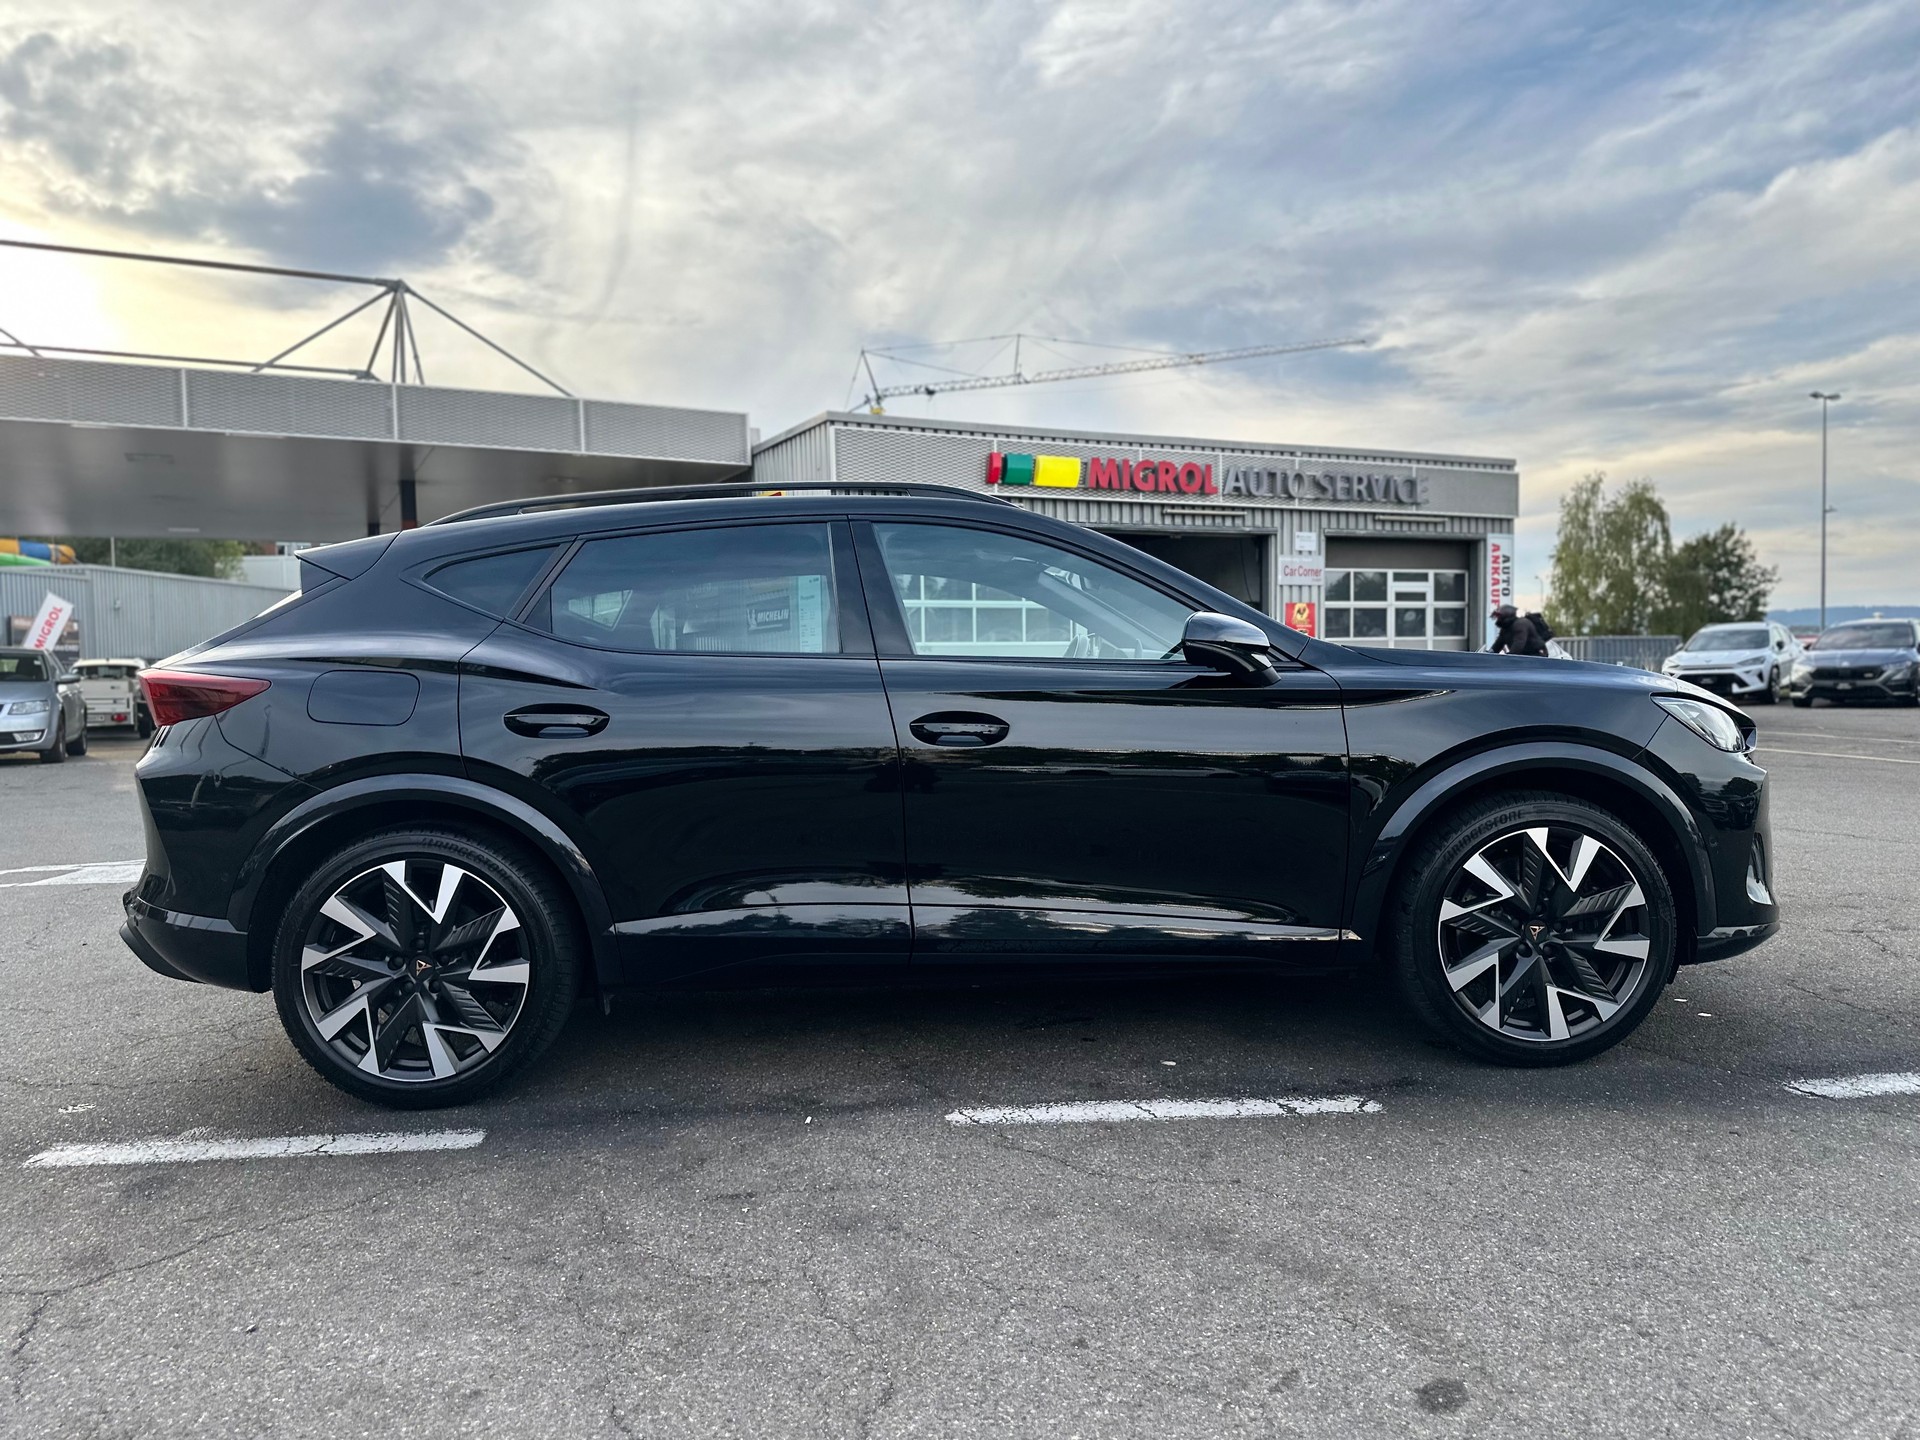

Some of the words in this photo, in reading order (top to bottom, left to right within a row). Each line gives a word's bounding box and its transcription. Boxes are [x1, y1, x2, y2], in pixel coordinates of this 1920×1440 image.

[1088, 457, 1218, 494] MIGROL
[1223, 466, 1308, 498] AUTO
[1318, 471, 1429, 506] SERVICE
[1283, 565, 1297, 577] Car
[1298, 565, 1322, 577] Corner
[1491, 543, 1502, 607] ANKAUF
[1501, 554, 1511, 597] AUTO
[34, 606, 63, 649] MIGROL
[756, 608, 790, 623] MICHELIN
